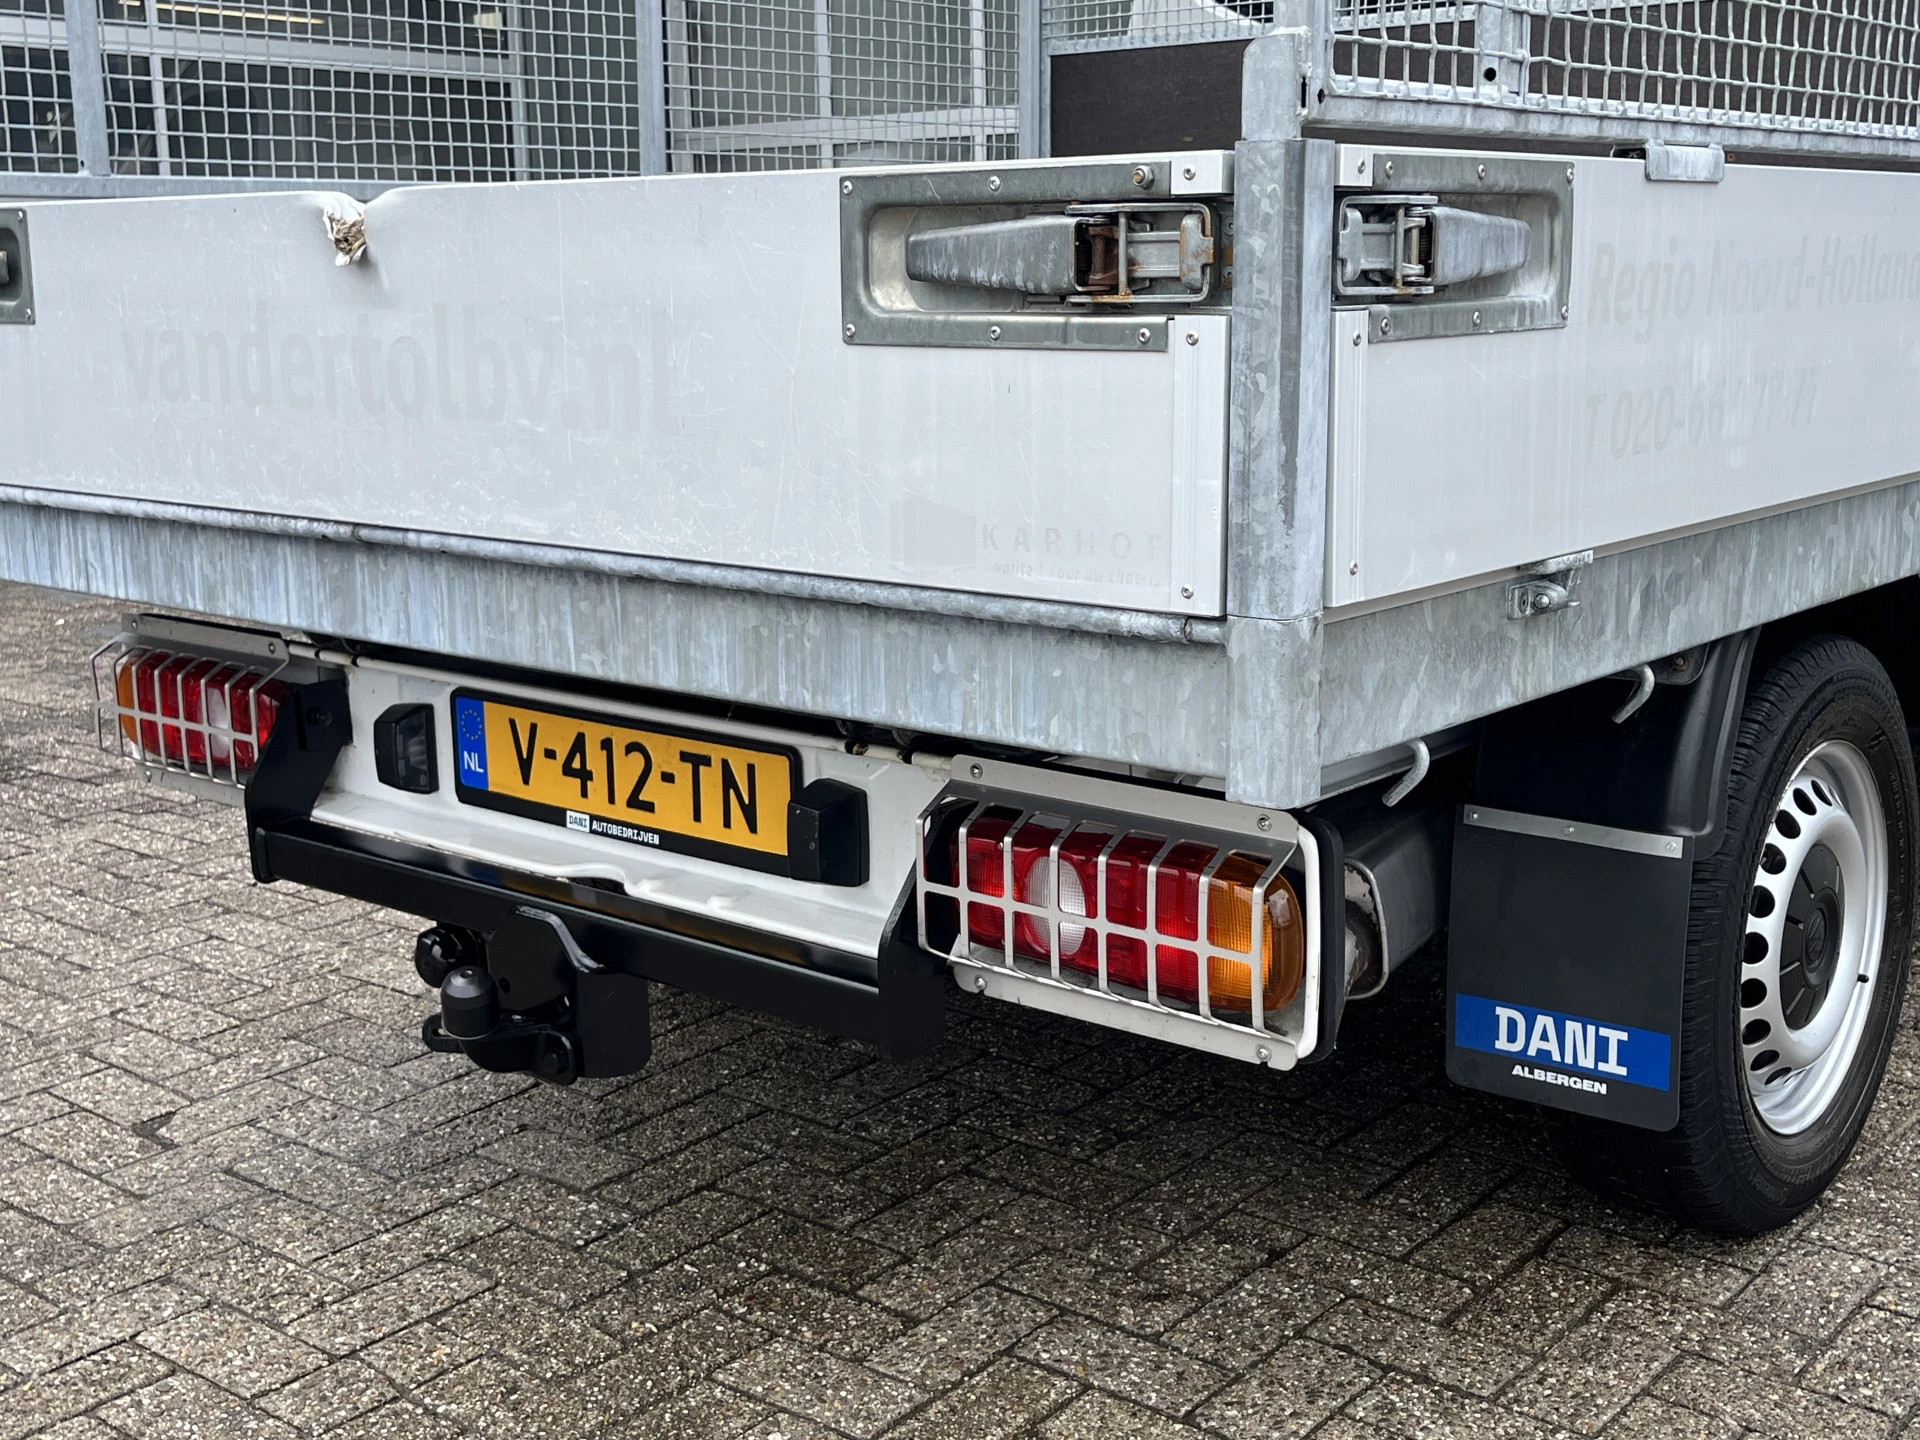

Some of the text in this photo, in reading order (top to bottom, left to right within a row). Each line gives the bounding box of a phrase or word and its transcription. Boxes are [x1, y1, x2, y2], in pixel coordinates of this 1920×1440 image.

[1587, 235, 1697, 345] Regio
[981, 523, 1163, 561] KARHOF
[463, 751, 485, 773] NL
[508, 717, 758, 835] V-412-TN
[568, 814, 660, 845] DANI AUTOBEDRIJVEN
[1494, 1006, 1629, 1077] DANI
[1511, 1064, 1608, 1095] ALBERGEN
